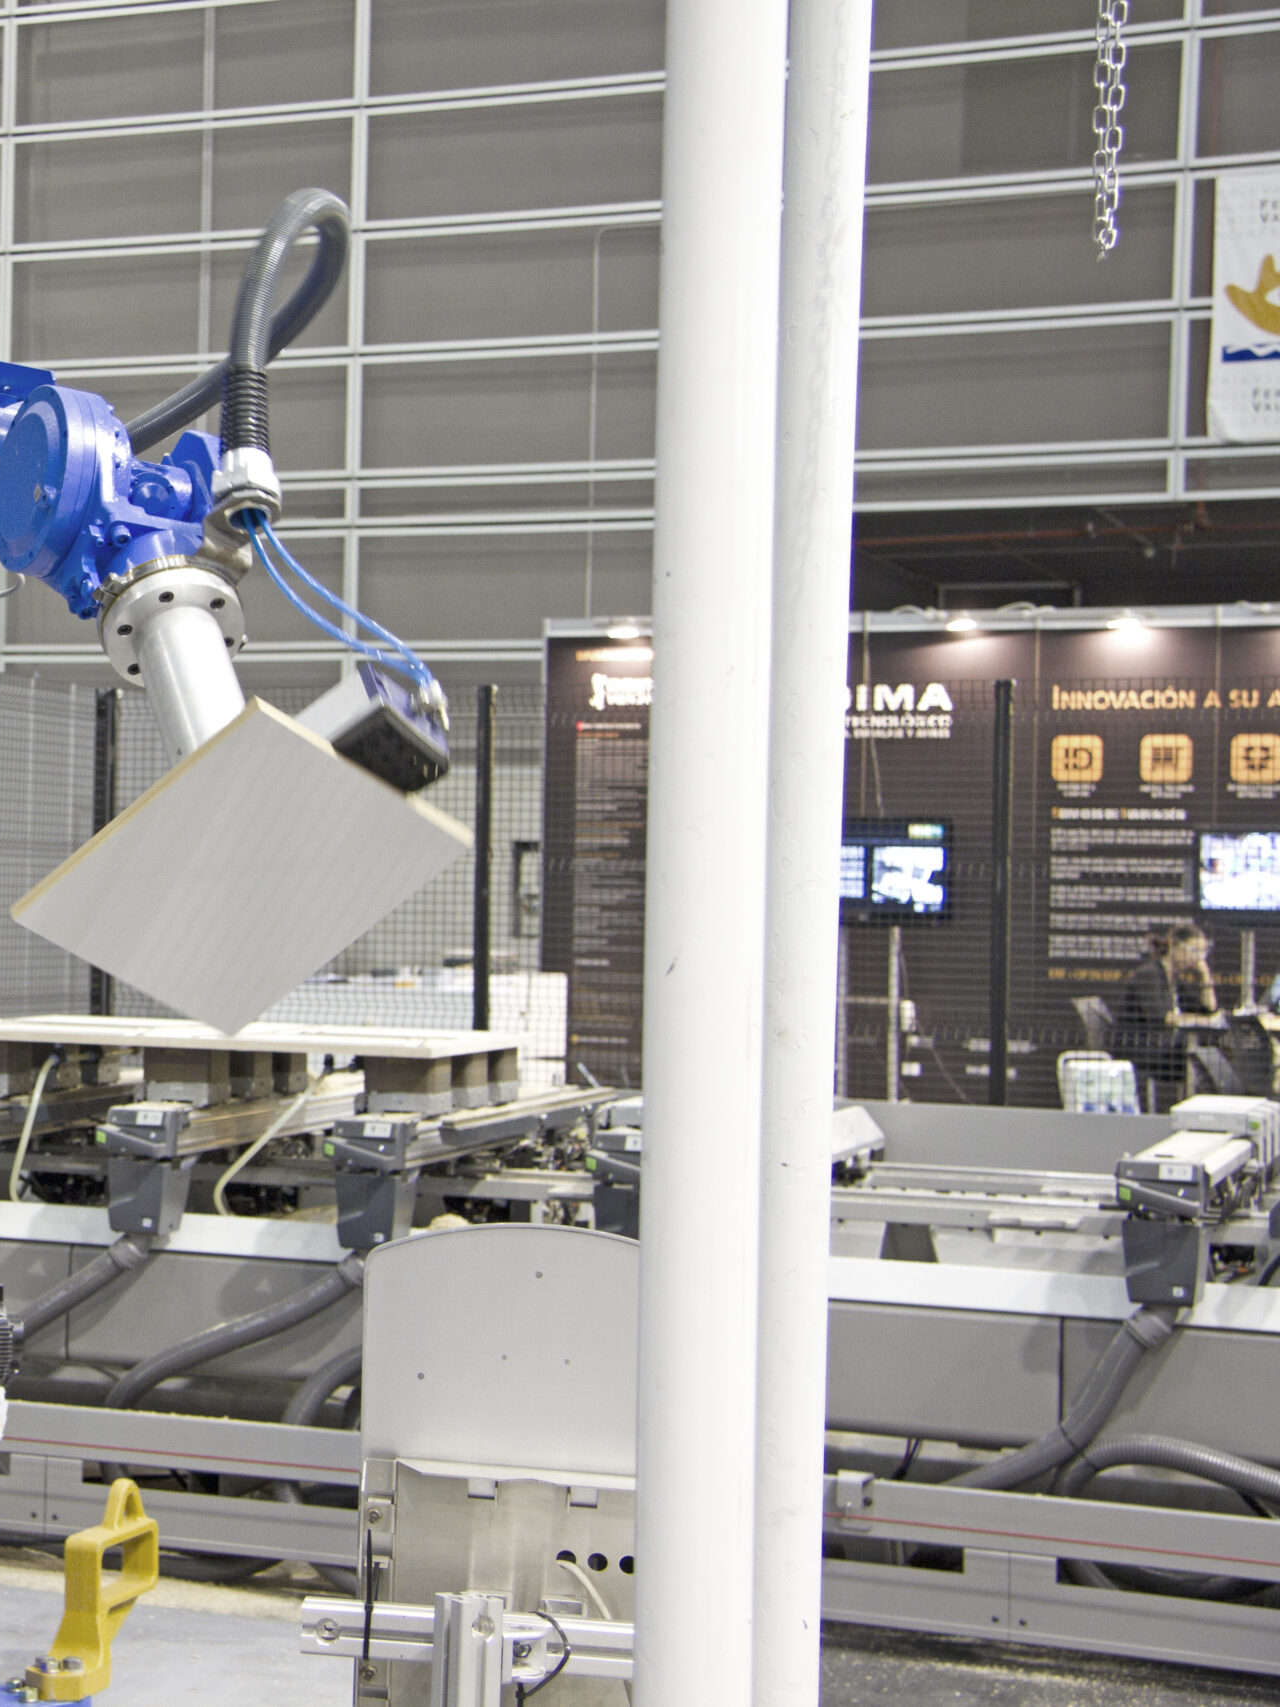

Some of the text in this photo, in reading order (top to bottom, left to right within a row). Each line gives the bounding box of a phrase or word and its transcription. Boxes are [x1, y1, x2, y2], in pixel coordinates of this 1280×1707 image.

[846, 683, 954, 711] IMA
[1203, 689, 1222, 708] A
[1229, 688, 1260, 708] SU
